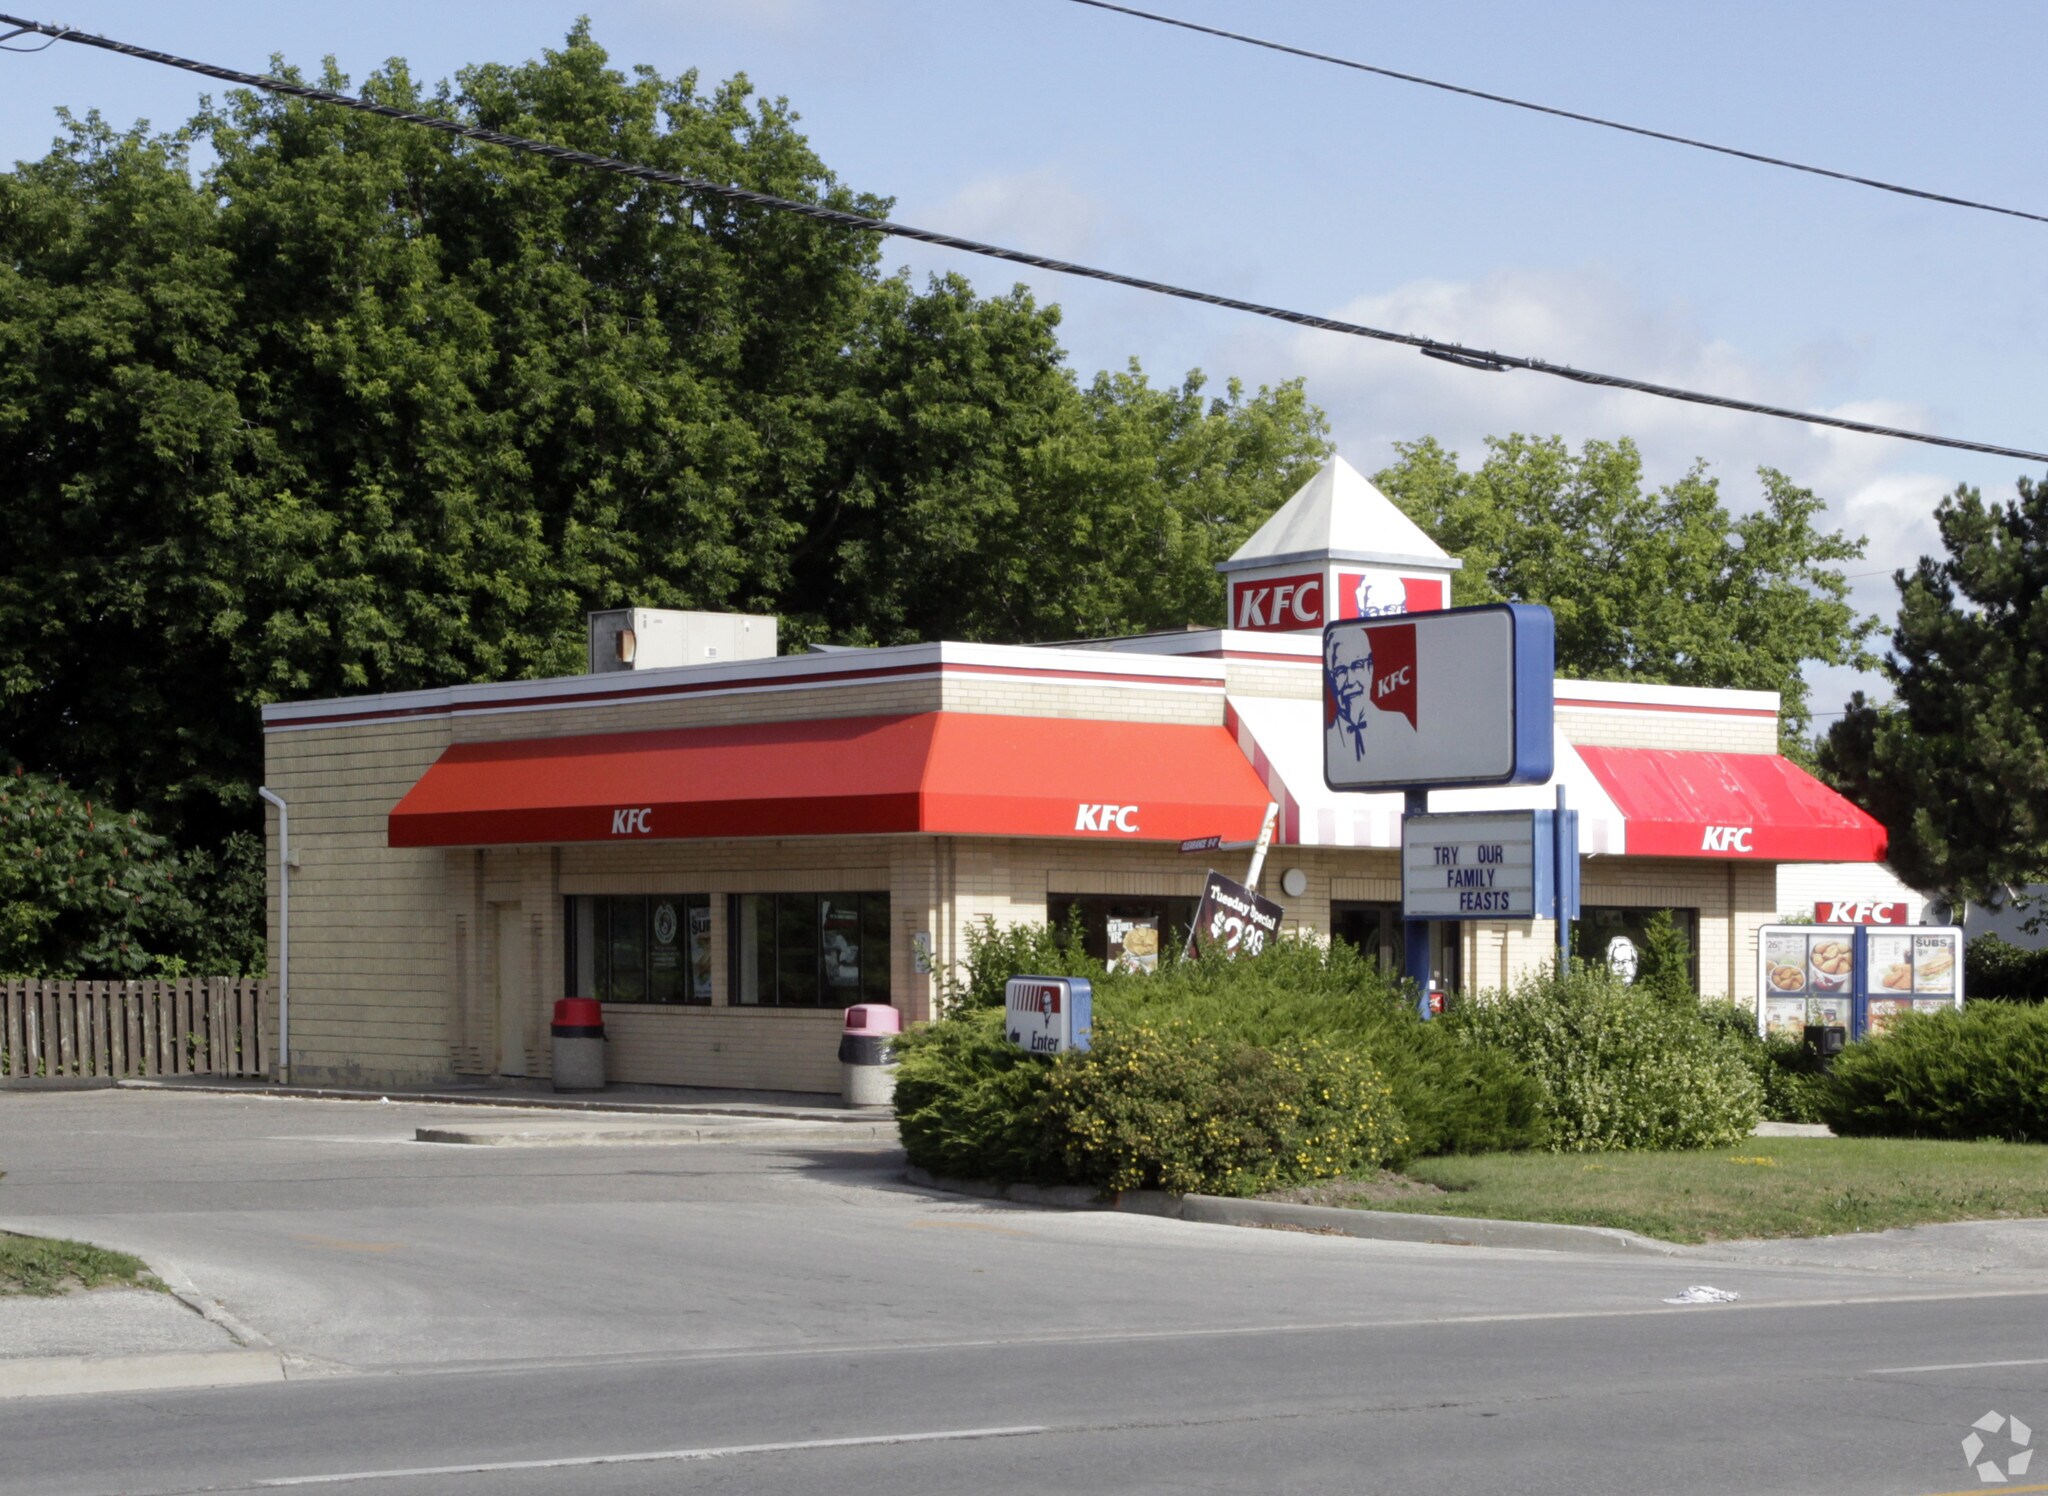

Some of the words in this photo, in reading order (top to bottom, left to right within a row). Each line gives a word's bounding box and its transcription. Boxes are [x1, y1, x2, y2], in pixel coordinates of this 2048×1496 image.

[1237, 580, 1320, 628] KFC
[1377, 665, 1411, 698] KFC
[611, 808, 652, 834] KFC
[1074, 804, 1139, 832] KFC
[1701, 826, 1753, 852] KFC
[1434, 847, 1458, 865] TRY
[1478, 845, 1503, 864] OUR
[1447, 868, 1495, 888] FAMILY
[1210, 885, 1250, 916] Tuesday
[1250, 902, 1276, 930] Special
[1460, 891, 1509, 910] FEASTS
[1827, 902, 1894, 924] KFC
[1915, 939, 1947, 947] SUBS
[1031, 1030, 1059, 1052] Enter
